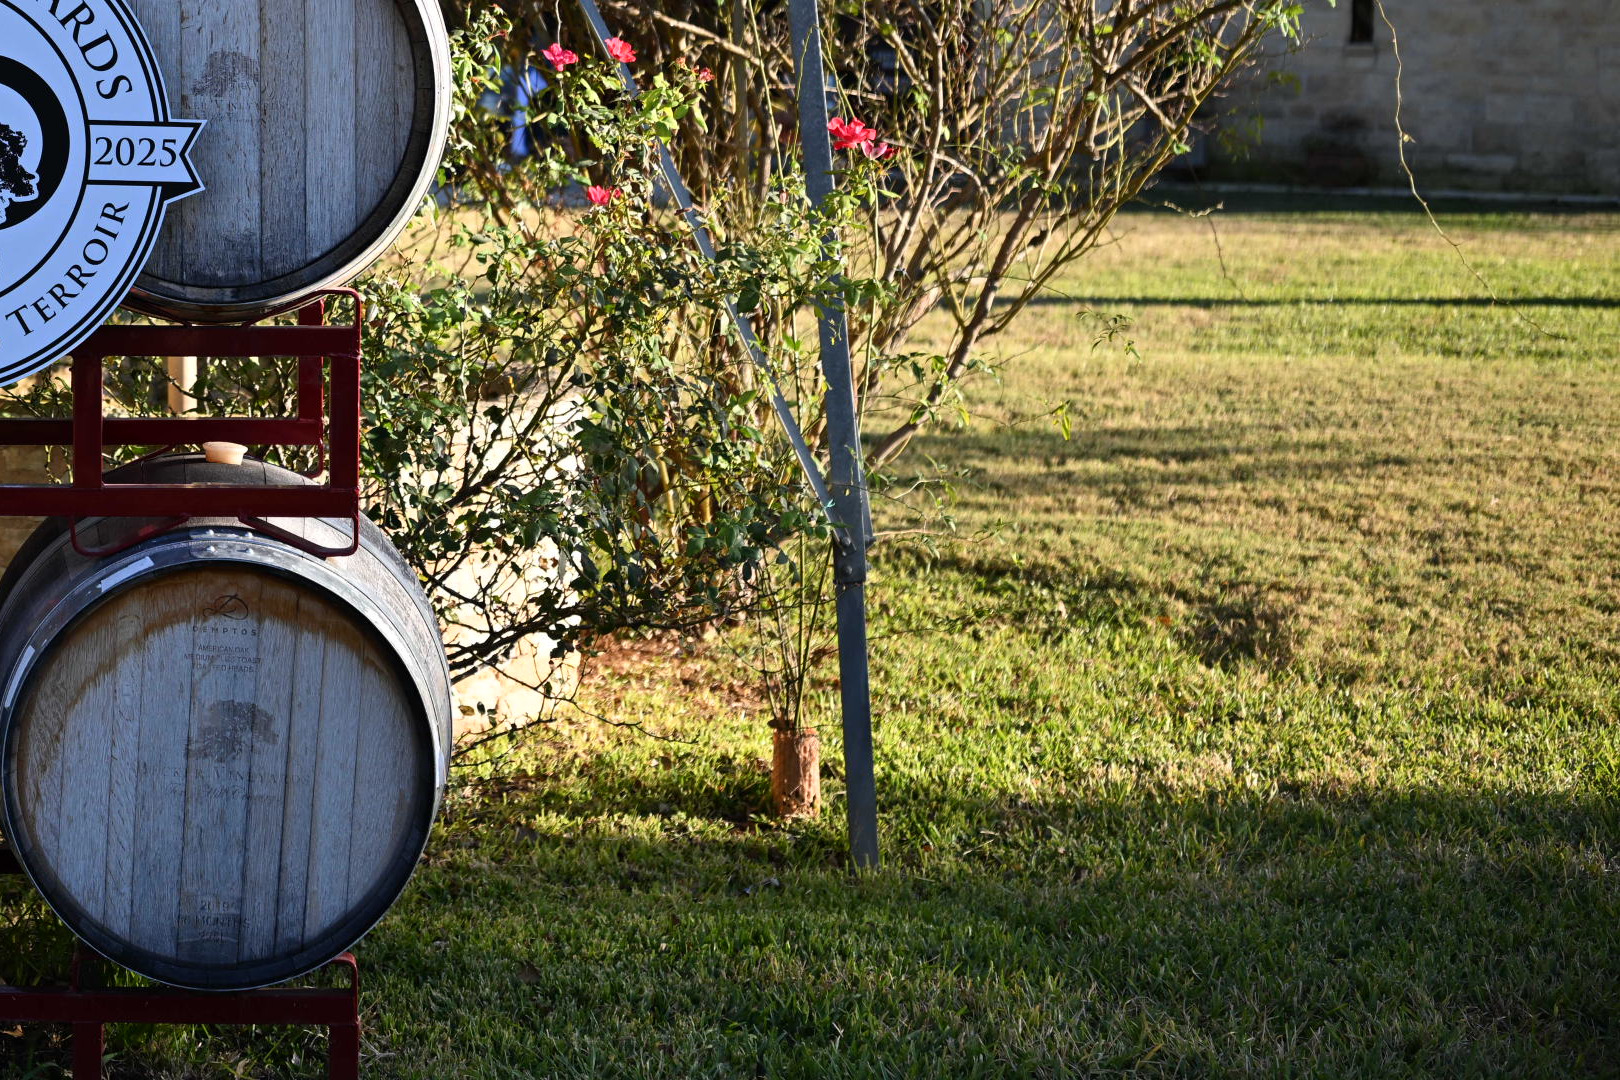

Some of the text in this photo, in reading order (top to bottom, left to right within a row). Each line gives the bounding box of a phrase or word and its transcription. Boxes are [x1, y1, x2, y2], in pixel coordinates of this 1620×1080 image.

[94, 136, 178, 168] 2025
[5, 199, 130, 337] TERROIR
[192, 625, 257, 636] DEMPTOS
